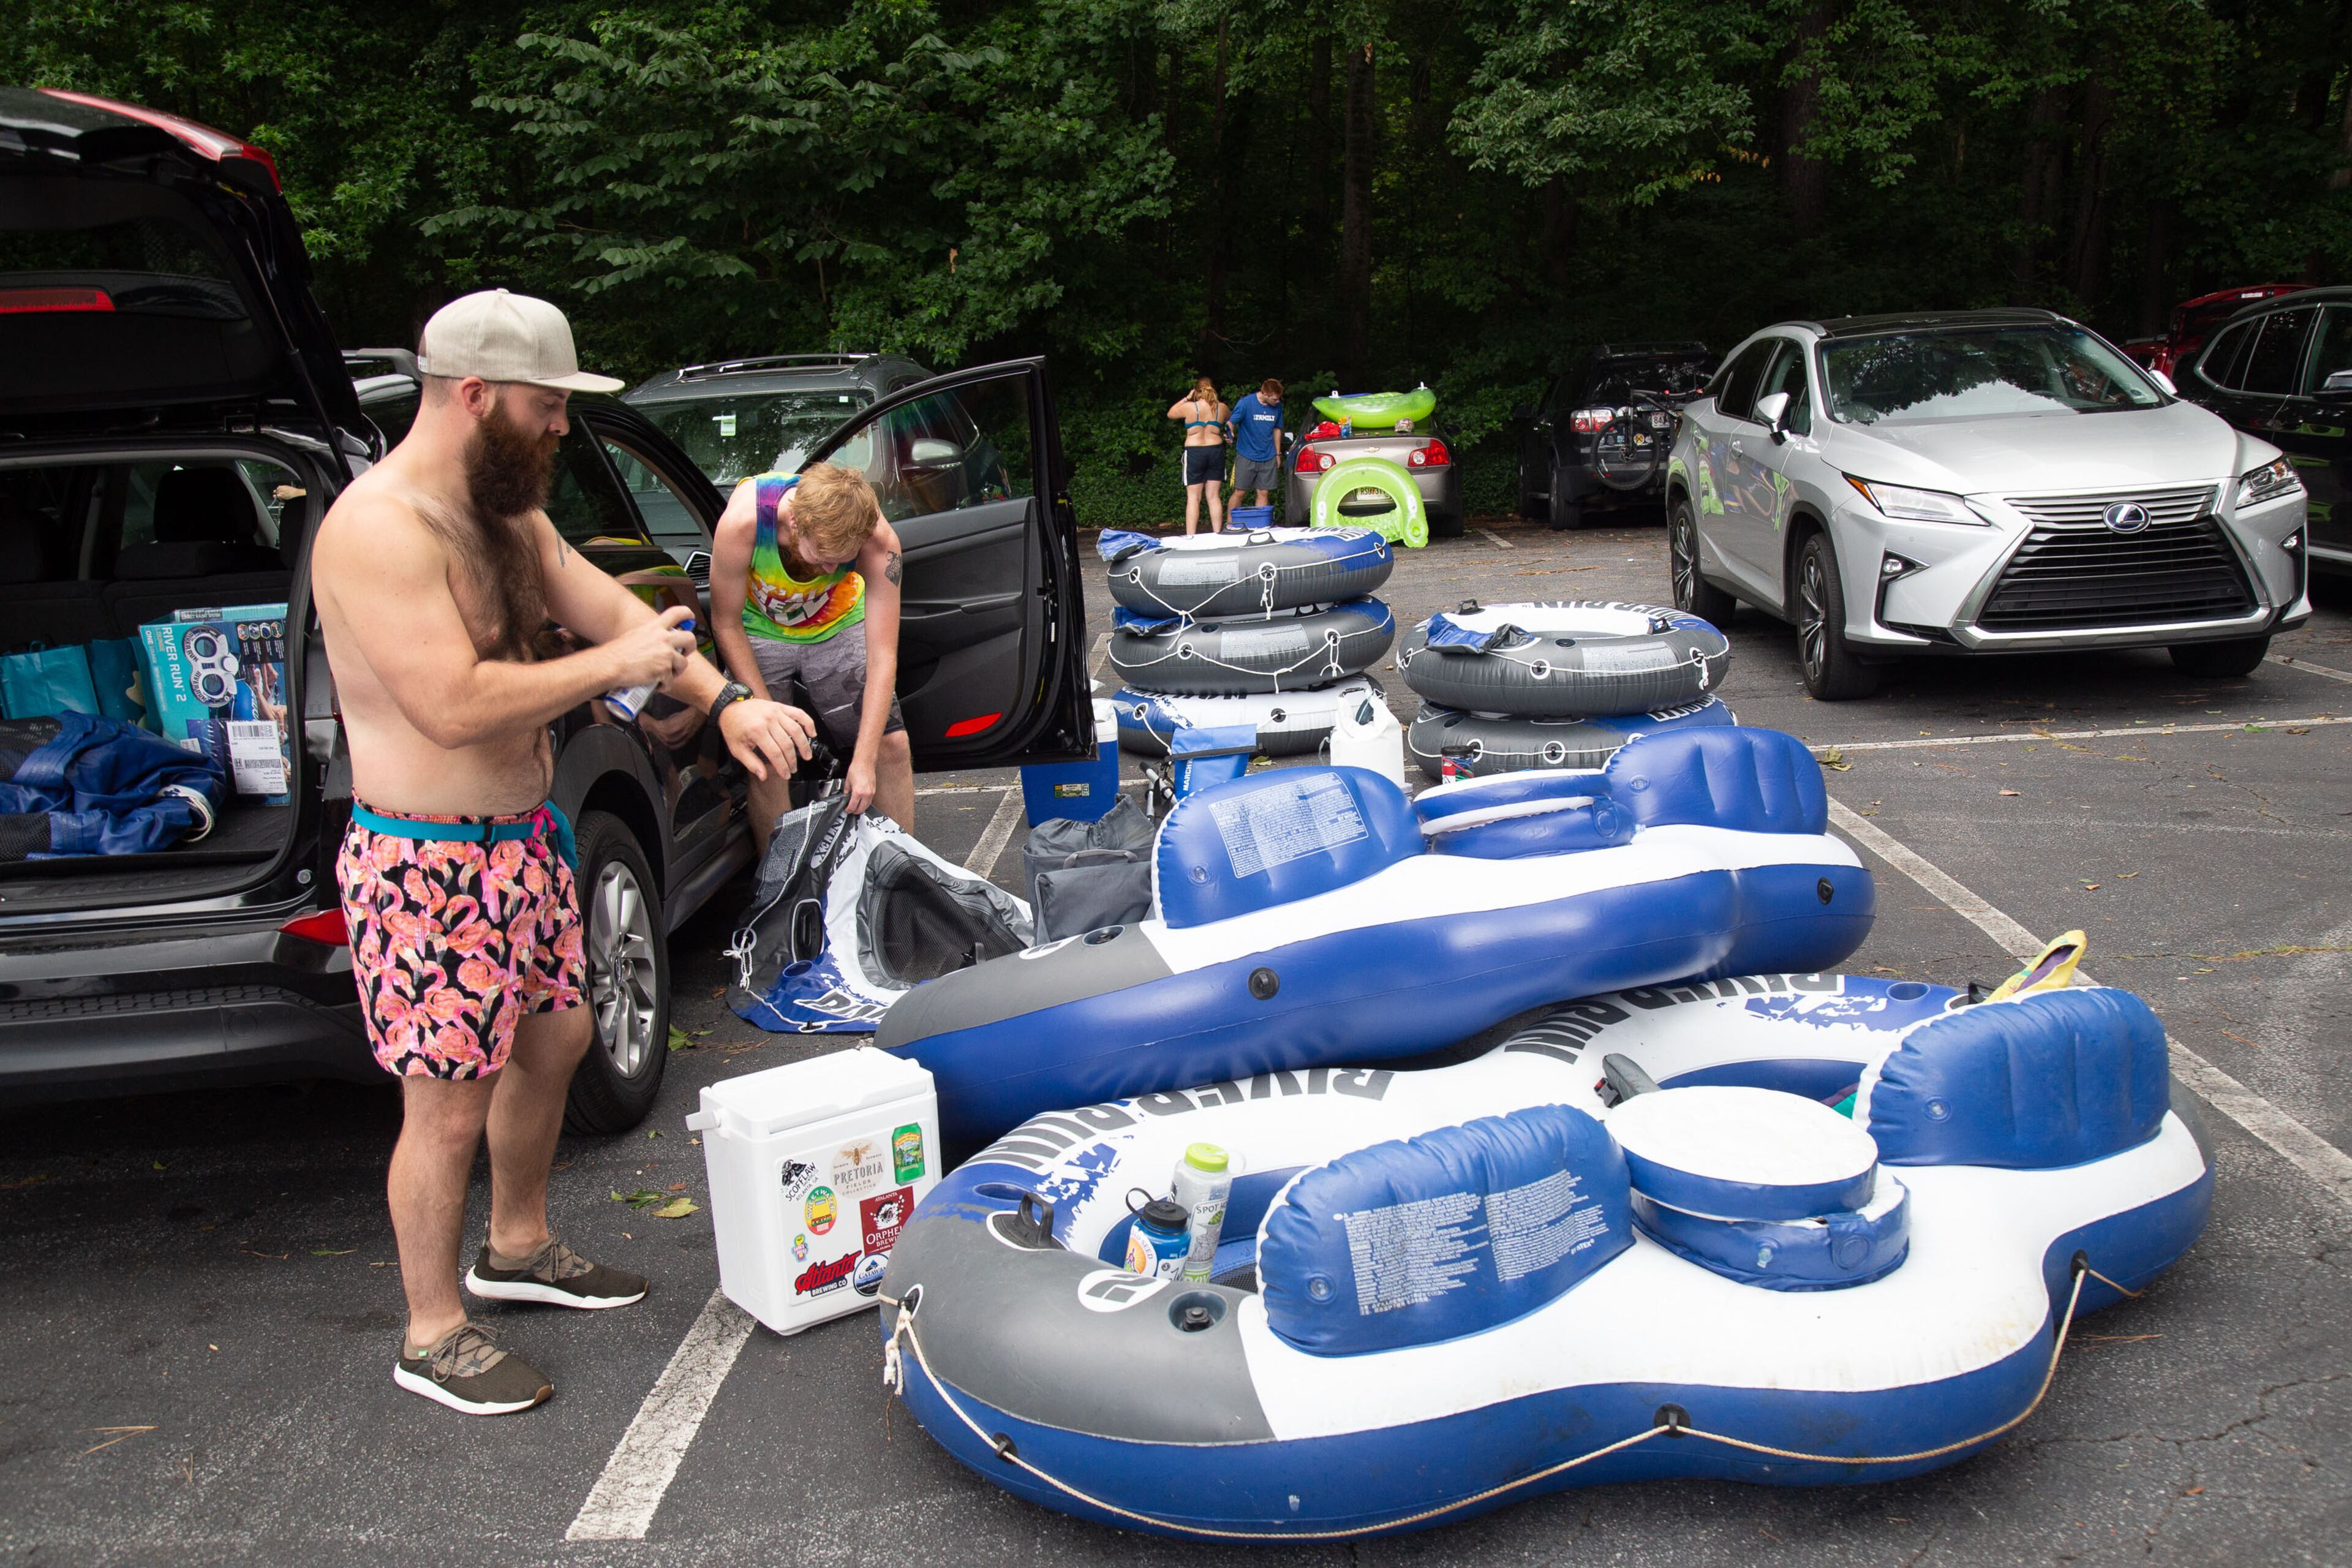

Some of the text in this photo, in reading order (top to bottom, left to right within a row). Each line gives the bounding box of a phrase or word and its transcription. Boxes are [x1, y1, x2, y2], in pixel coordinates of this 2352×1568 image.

[145, 630, 153, 645] ONE
[162, 627, 186, 703] RIVER RUN 2
[816, 812, 848, 860] INTEX
[785, 1161, 816, 1202] SCOFFLAW
[834, 1161, 883, 1186] PRETORIA
[796, 1183, 813, 1202] ATLANTA
[842, 1183, 876, 1196] COLLECTIVE
[846, 1179, 871, 1189] FIELDS
[807, 1189, 835, 1219] SWEETWATER
[1196, 1204, 1219, 1214] SPOT
[866, 1226, 902, 1245] ORPHE
[876, 1235, 899, 1247] BREWI
[1141, 1240, 1153, 1260] SEED
[795, 1250, 862, 1295] Atlanta
[812, 1282, 838, 1295] BREWING
